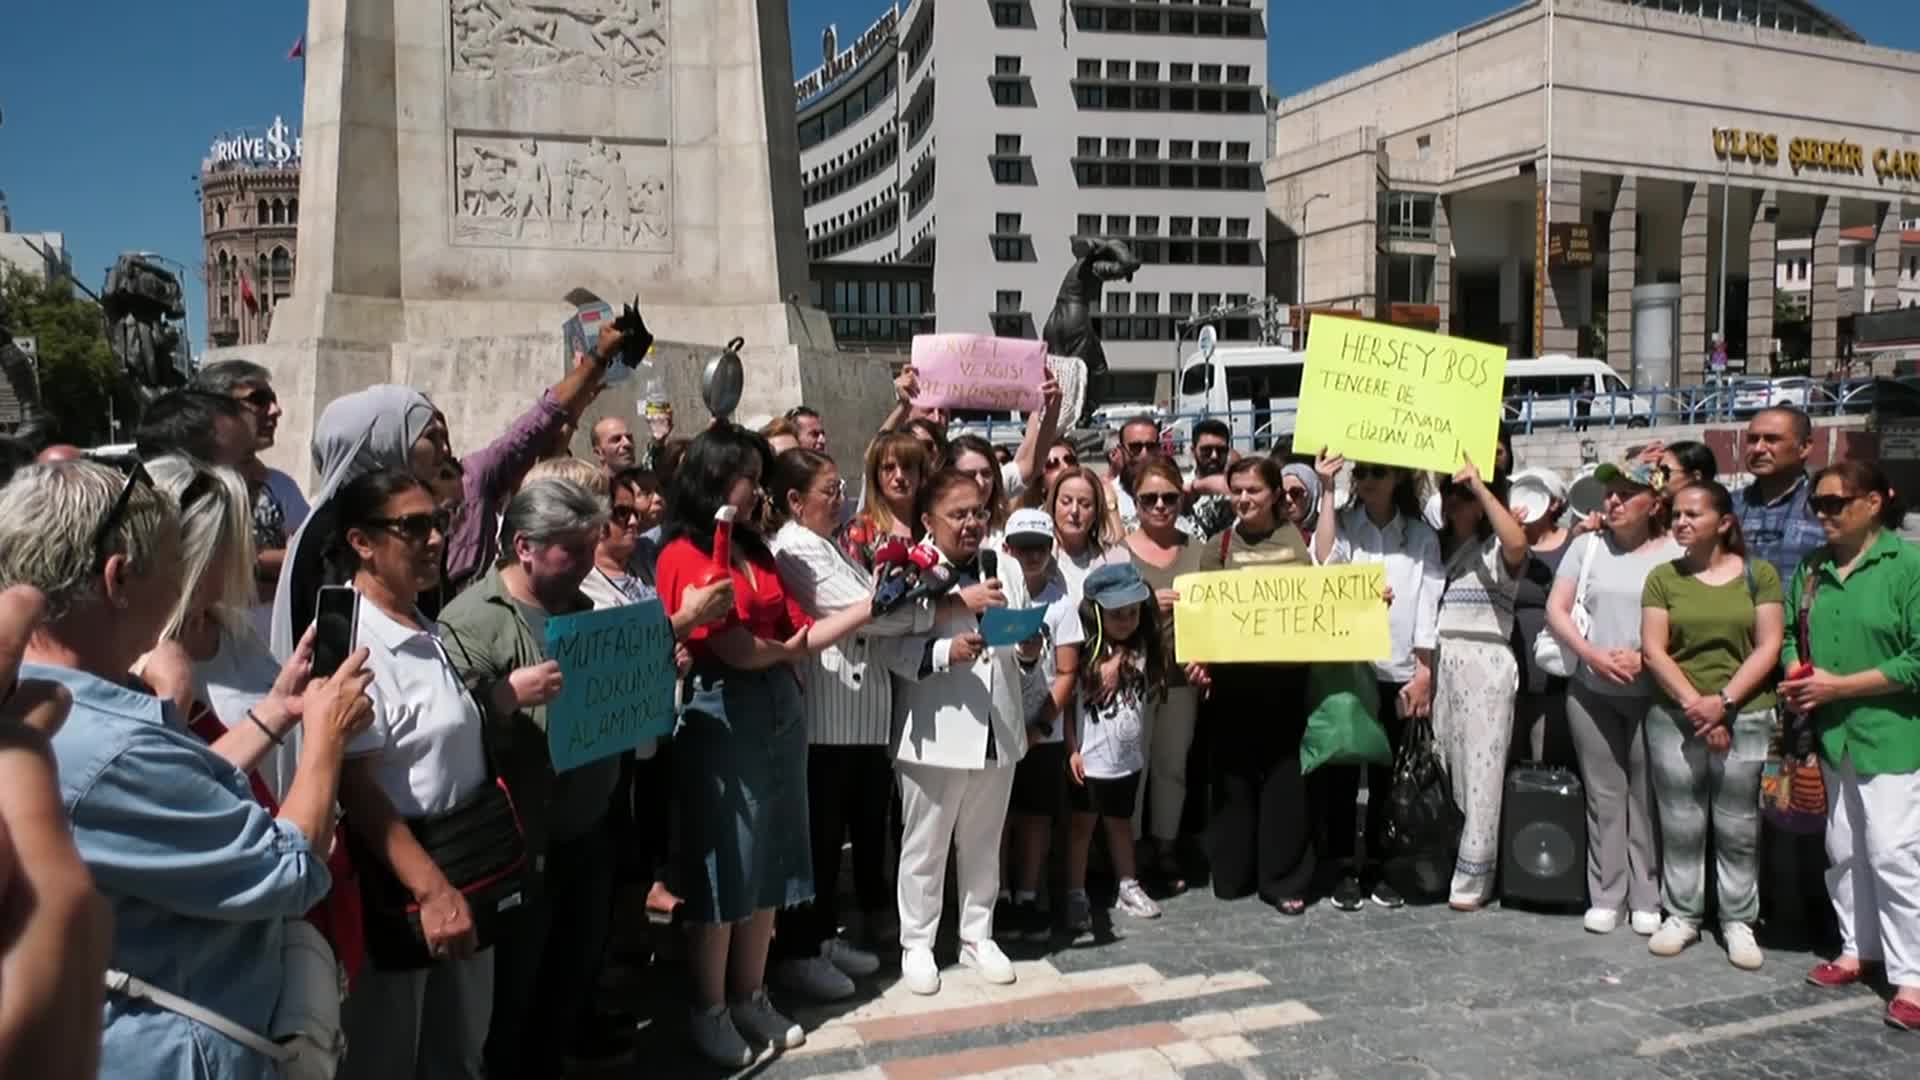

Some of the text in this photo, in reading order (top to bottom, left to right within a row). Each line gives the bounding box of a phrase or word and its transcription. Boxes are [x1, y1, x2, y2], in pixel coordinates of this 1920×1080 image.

[1712, 127, 1778, 165] ULUS
[1788, 137, 1863, 176] ŞEHİR
[1320, 368, 1415, 405] TENCERE DE
[1440, 349, 1489, 389] BOŞ
[1345, 416, 1409, 445] CÜZDAN
[1414, 431, 1434, 450] DA
[1189, 573, 1382, 604] DARLANDIK ARTIK
